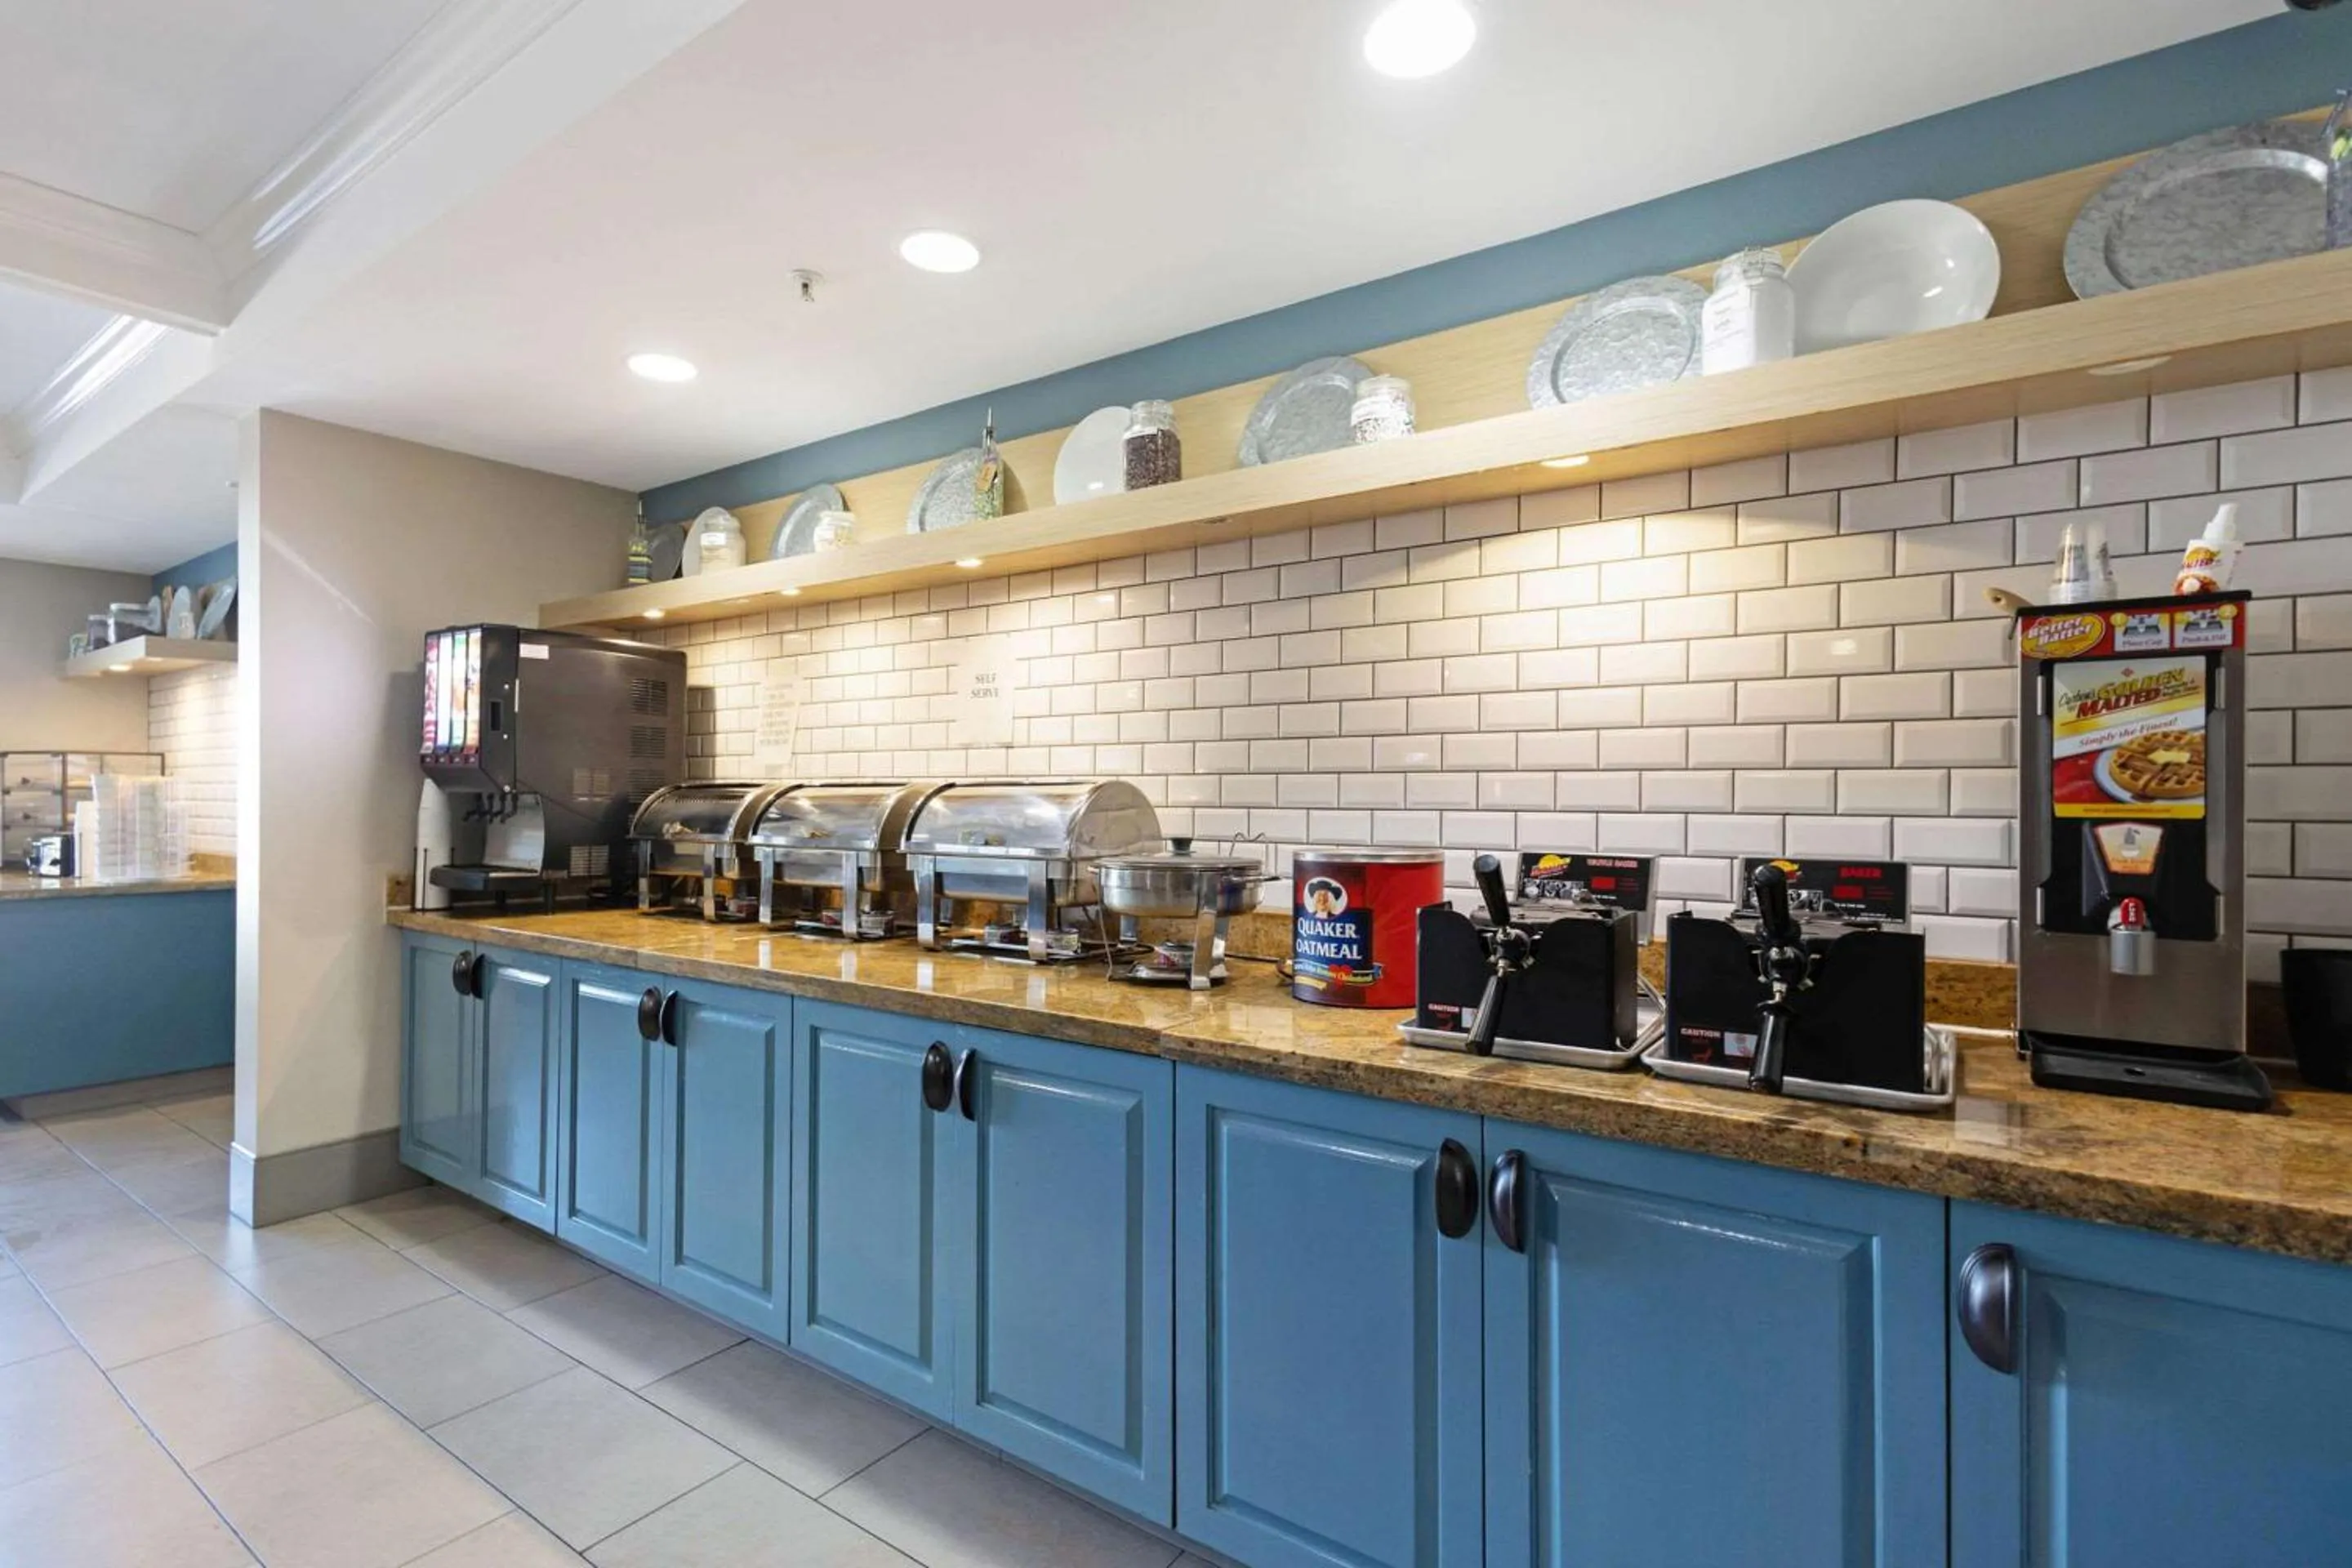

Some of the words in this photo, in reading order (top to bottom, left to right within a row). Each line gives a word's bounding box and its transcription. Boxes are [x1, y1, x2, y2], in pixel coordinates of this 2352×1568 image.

[2028, 617, 2082, 639] Better
[2038, 624, 2092, 645] Batter
[975, 672, 996, 684] SELF
[2097, 667, 2185, 700] GOLDEN
[970, 688, 999, 698] SERVE
[2076, 687, 2162, 719] MALTED
[2079, 732, 2117, 746] Simply
[2119, 727, 2139, 739] the
[1840, 866, 1882, 879] BAKER
[1298, 916, 1357, 938] QUAKER
[1296, 938, 1362, 960] OATMEAL
[1681, 1027, 1721, 1039] CAUTION
